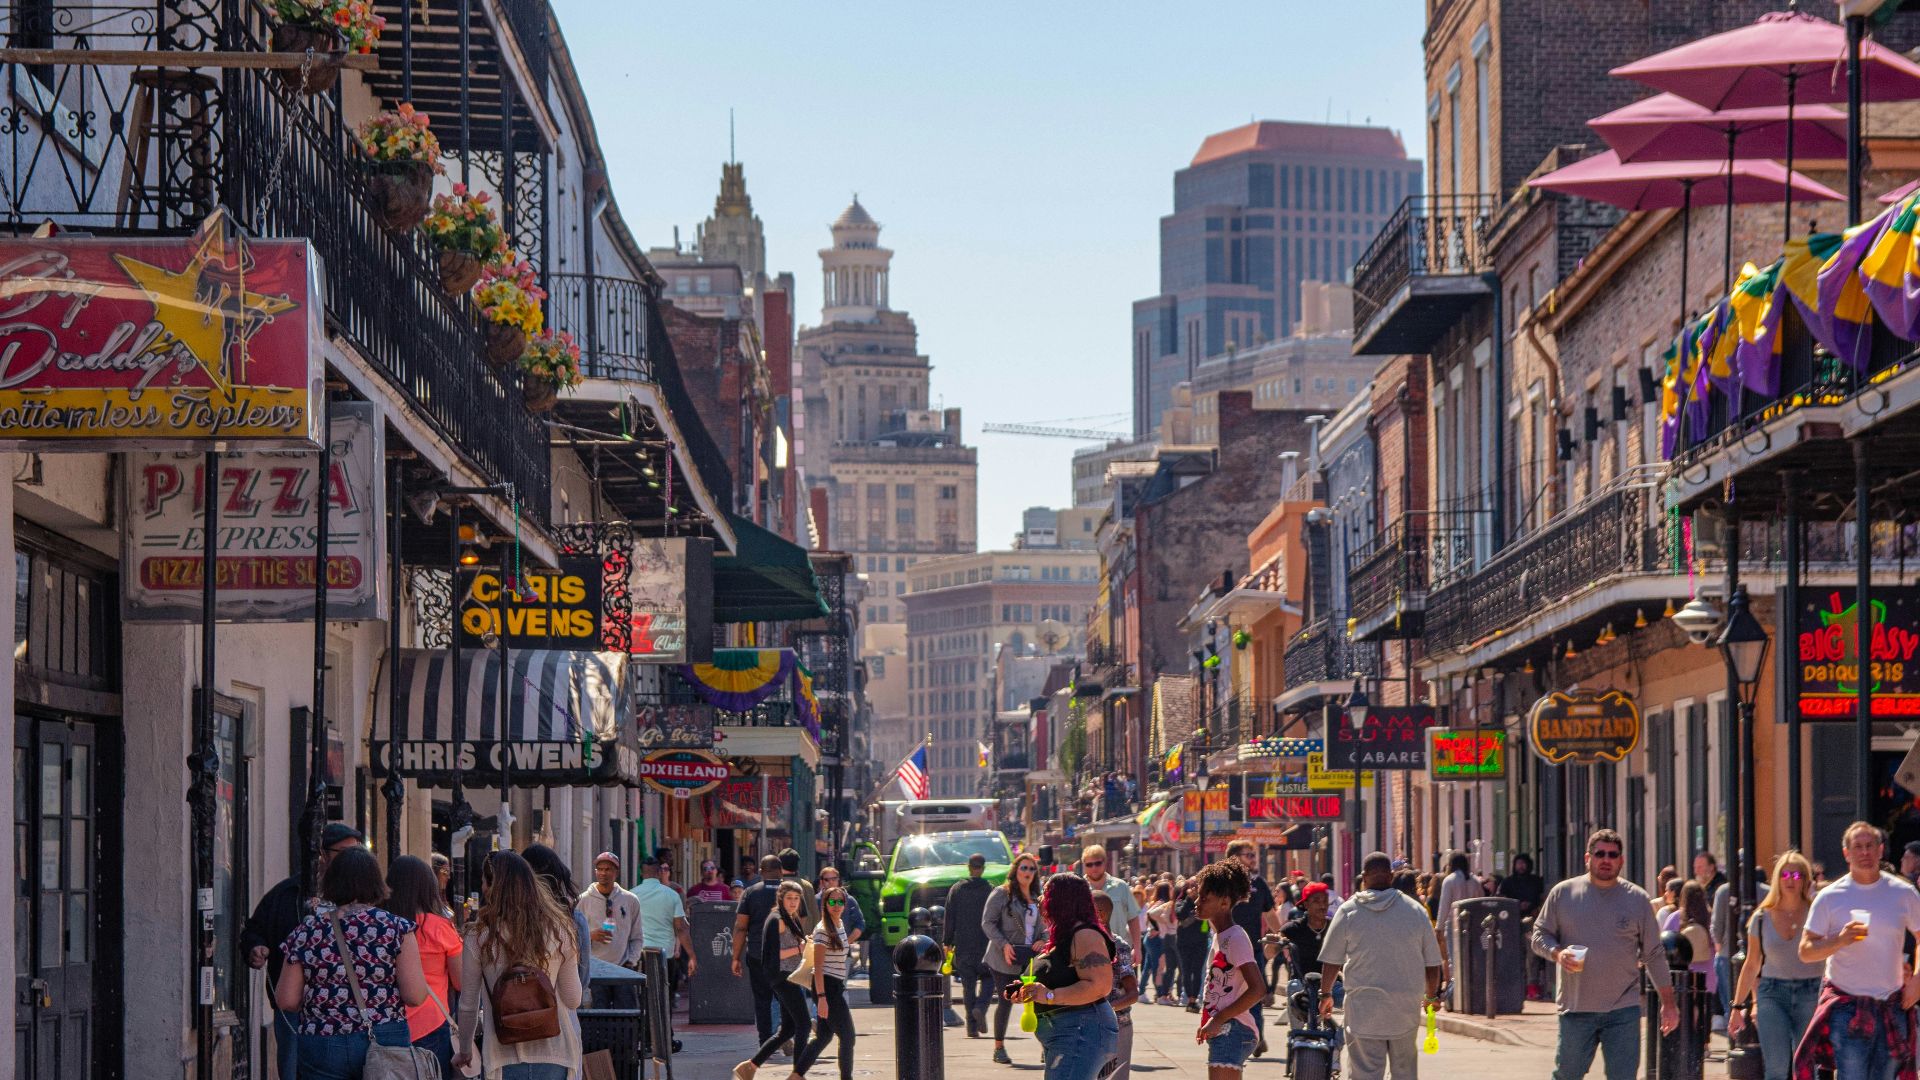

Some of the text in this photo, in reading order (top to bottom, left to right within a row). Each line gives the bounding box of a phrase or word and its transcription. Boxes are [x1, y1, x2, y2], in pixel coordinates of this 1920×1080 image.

[168, 394, 301, 434] Topless
[142, 462, 359, 520] PIZZA
[216, 559, 240, 585] BY
[248, 560, 289, 585] THE
[295, 558, 352, 586] SLCE
[463, 608, 593, 637] OWENS
[653, 635, 682, 650] Club
[1799, 623, 1845, 661] BIG
[1338, 728, 1426, 742] SUTR
[1540, 717, 1634, 739] BANDSTAND
[380, 742, 476, 770] CHRIS
[489, 742, 603, 770] OWENS
[641, 763, 728, 778] DIXIELAND
[675, 788, 689, 797] ATM
[1249, 797, 1340, 817] BARELY LEGAL CLUB
